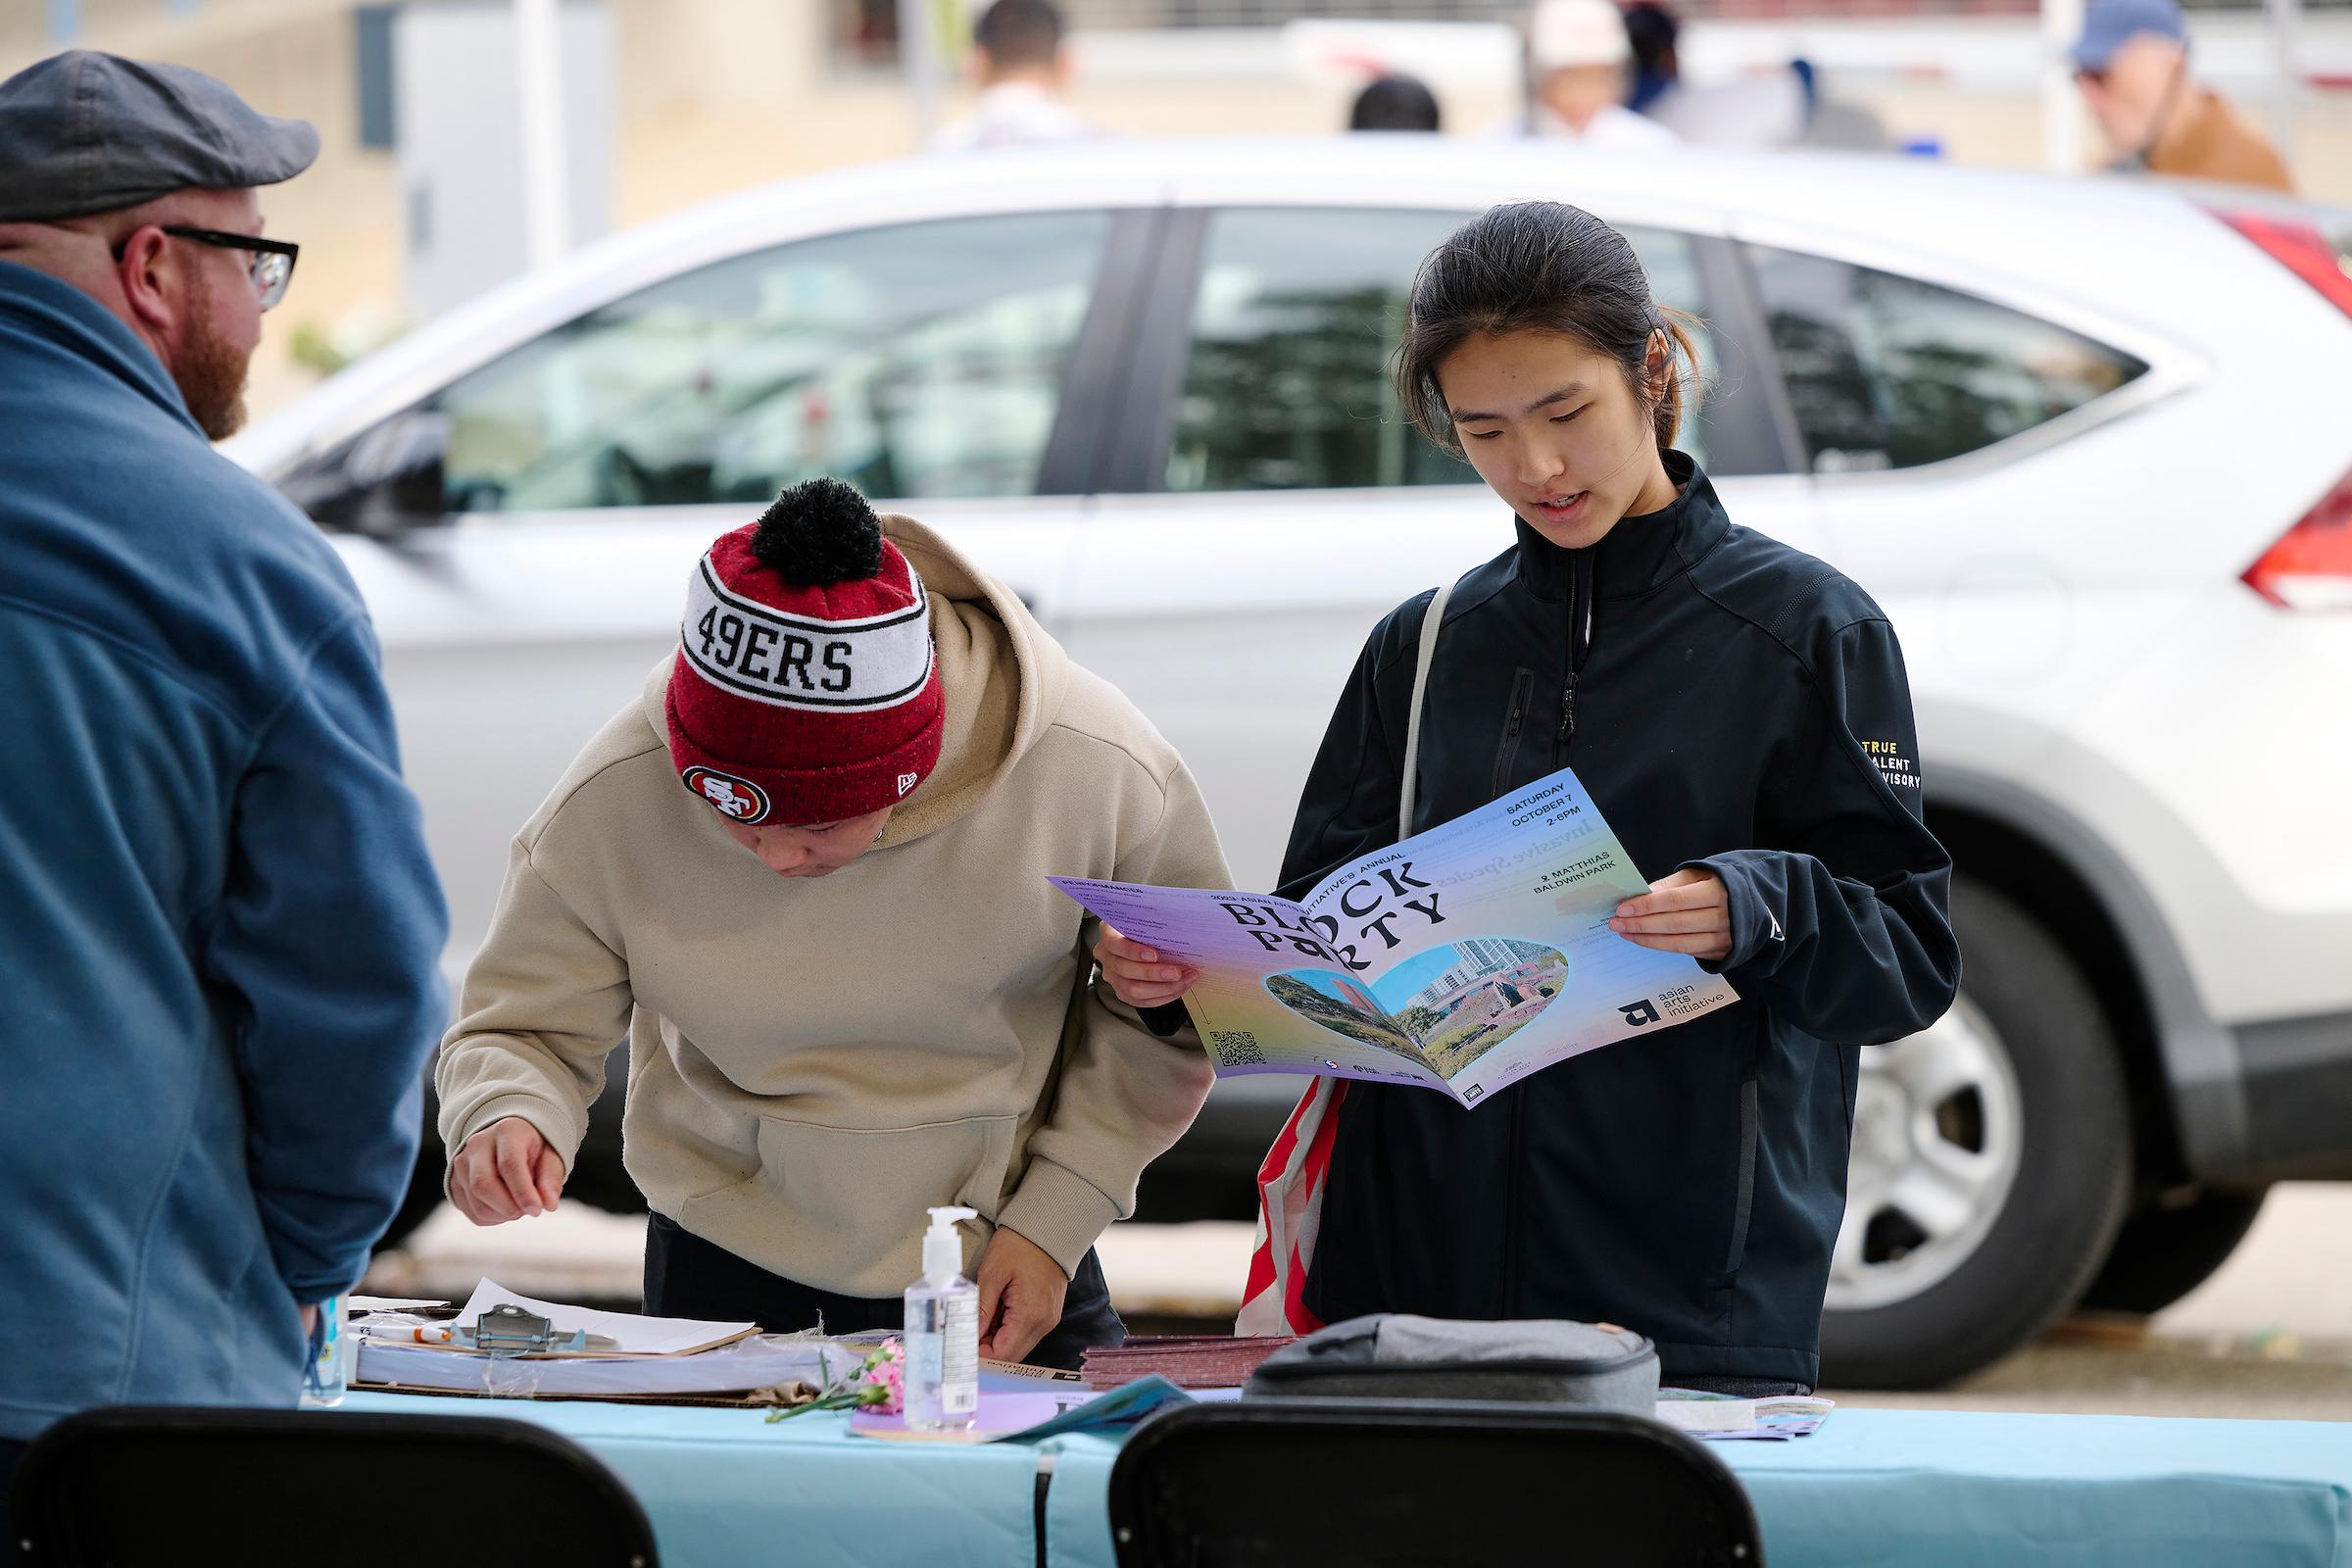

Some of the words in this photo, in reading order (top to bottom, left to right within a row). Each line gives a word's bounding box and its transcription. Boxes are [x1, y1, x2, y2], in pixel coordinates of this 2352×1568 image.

[699, 605, 852, 693] 49ERS
[1861, 741, 1897, 754] TRUE
[1871, 757, 1910, 771] ALENT
[1882, 772, 1921, 788] VISORY
[1506, 783, 1564, 814] SATURDAY
[1512, 798, 1565, 826] OCTOBER
[1546, 806, 1581, 826] 2-6PM
[1534, 873, 1585, 894] BALDWIN
[1586, 860, 1616, 876] PARK
[1552, 852, 1610, 878] MATTHIAS
[1300, 872, 1355, 915] NITIATIVE'S
[1360, 853, 1406, 873] ANNUAL
[1218, 862, 1432, 945] BLOCK
[1658, 985, 1694, 1001] asian
[1663, 995, 1691, 1008] arts
[1667, 994, 1725, 1017] initiative
